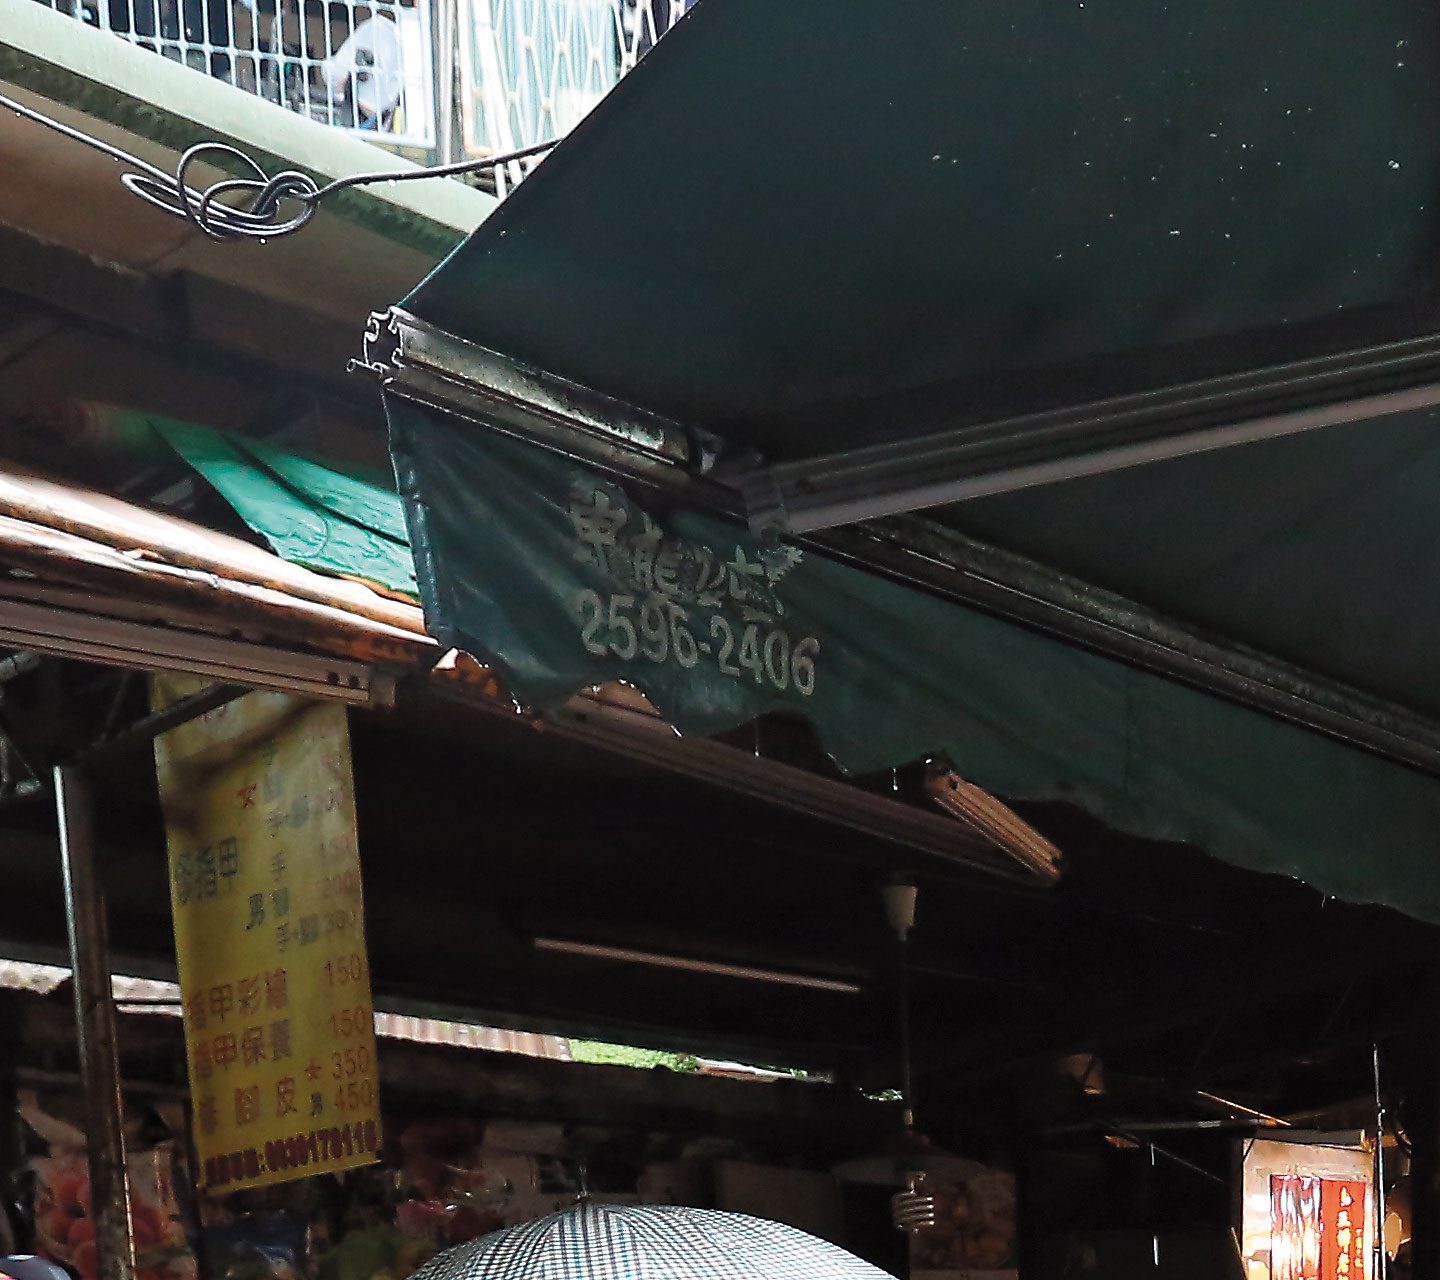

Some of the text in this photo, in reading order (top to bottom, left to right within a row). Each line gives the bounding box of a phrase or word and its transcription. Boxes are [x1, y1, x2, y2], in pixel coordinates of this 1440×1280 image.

[580, 588, 822, 697] 2596-2406
[323, 952, 363, 987] 150
[327, 1005, 367, 1039] 150
[331, 1045, 370, 1079] 350
[334, 1078, 373, 1112] 450
